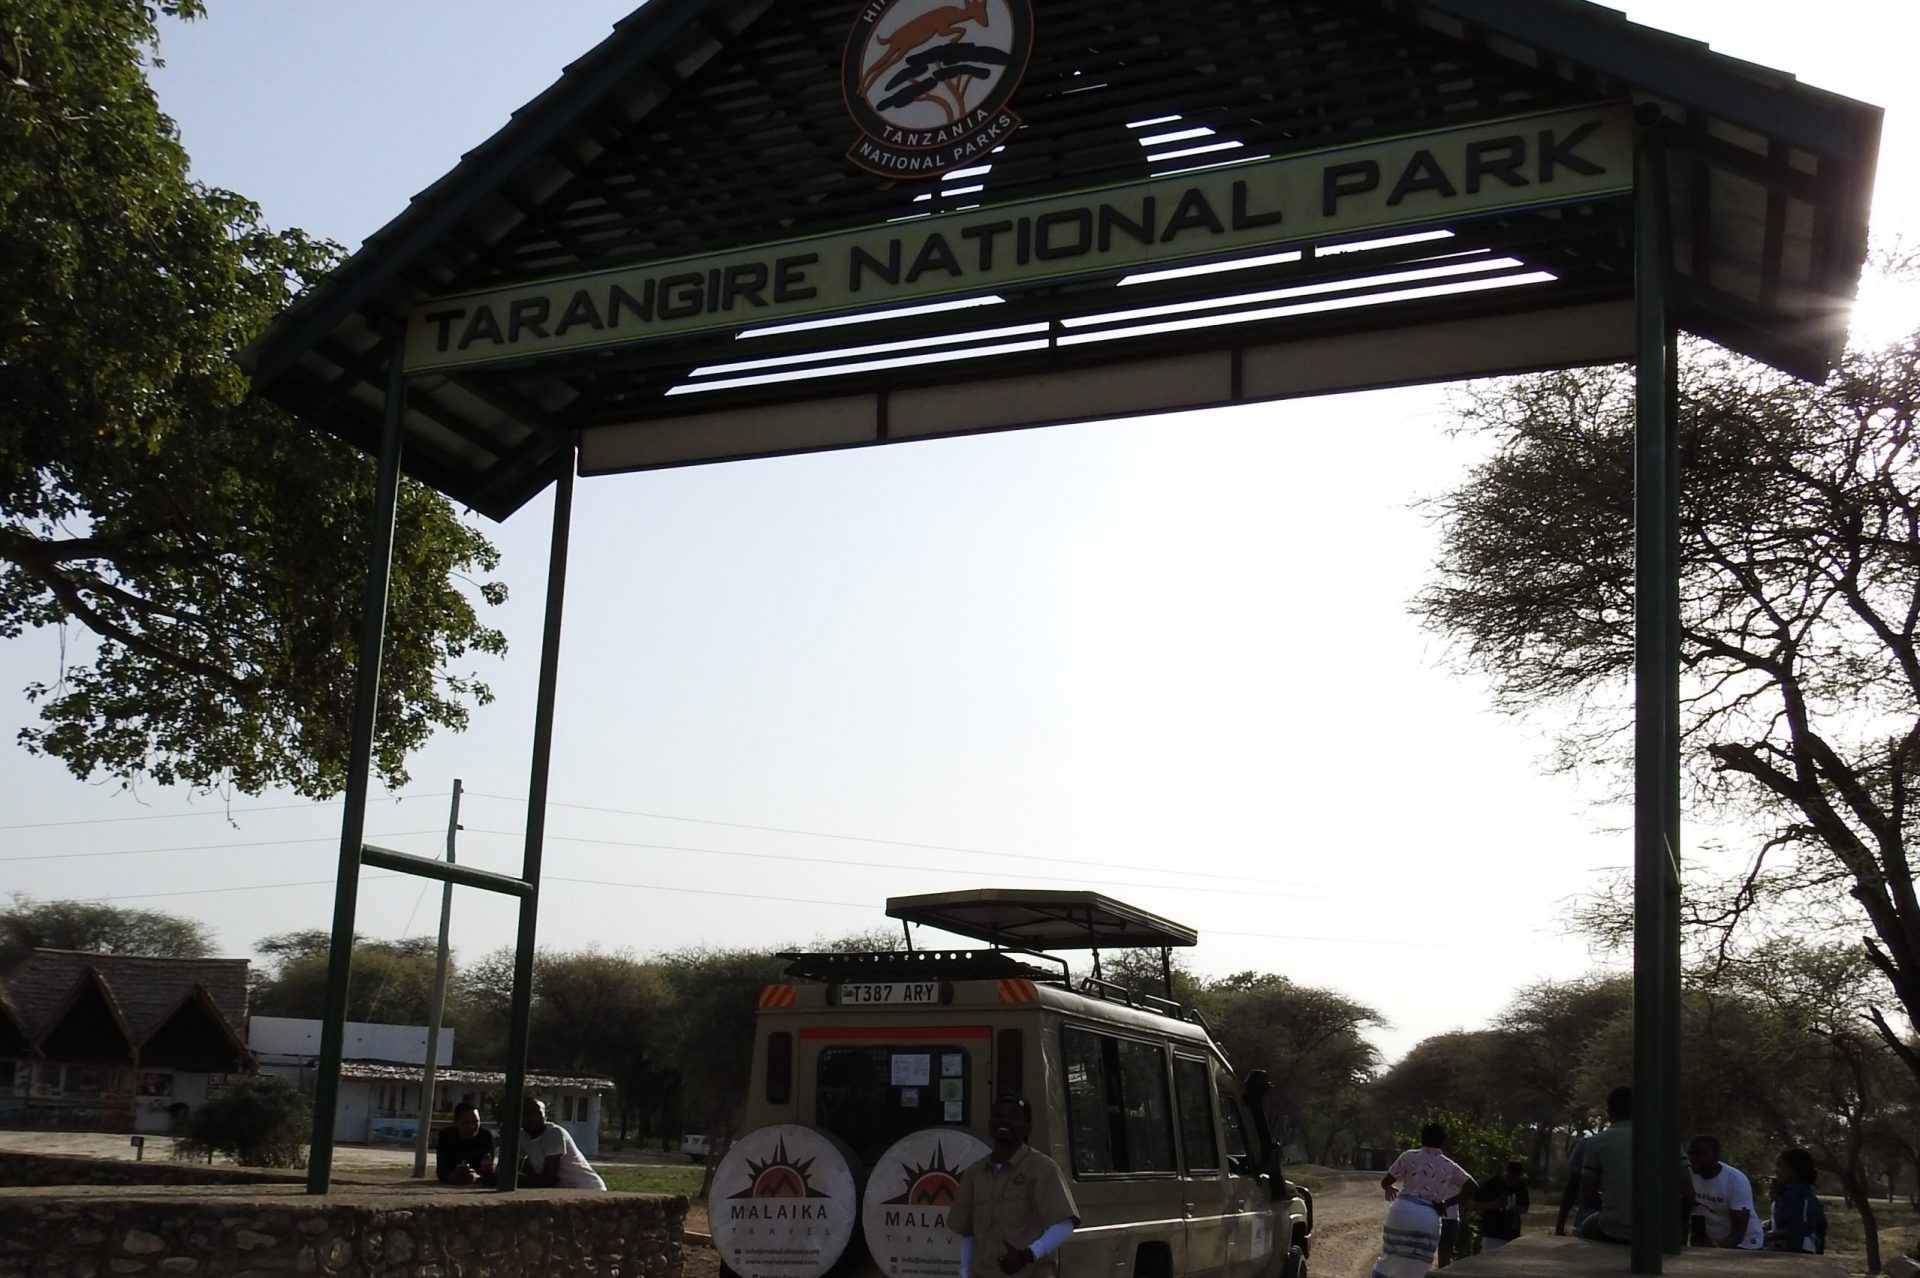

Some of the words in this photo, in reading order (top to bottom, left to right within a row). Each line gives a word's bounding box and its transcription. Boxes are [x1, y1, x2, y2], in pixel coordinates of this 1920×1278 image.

[882, 109, 989, 145] TANZANIA
[860, 142, 945, 170] NATIONAL
[953, 114, 1011, 160] PARKS
[425, 252, 820, 353] TARANGIRE
[849, 180, 1282, 292] NATIONAL
[1322, 121, 1606, 217] PARK
[853, 985, 893, 1002] T387
[904, 984, 934, 1001] ARY
[731, 1205, 828, 1220] MALAIKA
[885, 1211, 945, 1228] MALA
[731, 1227, 833, 1236] TRAVEL
